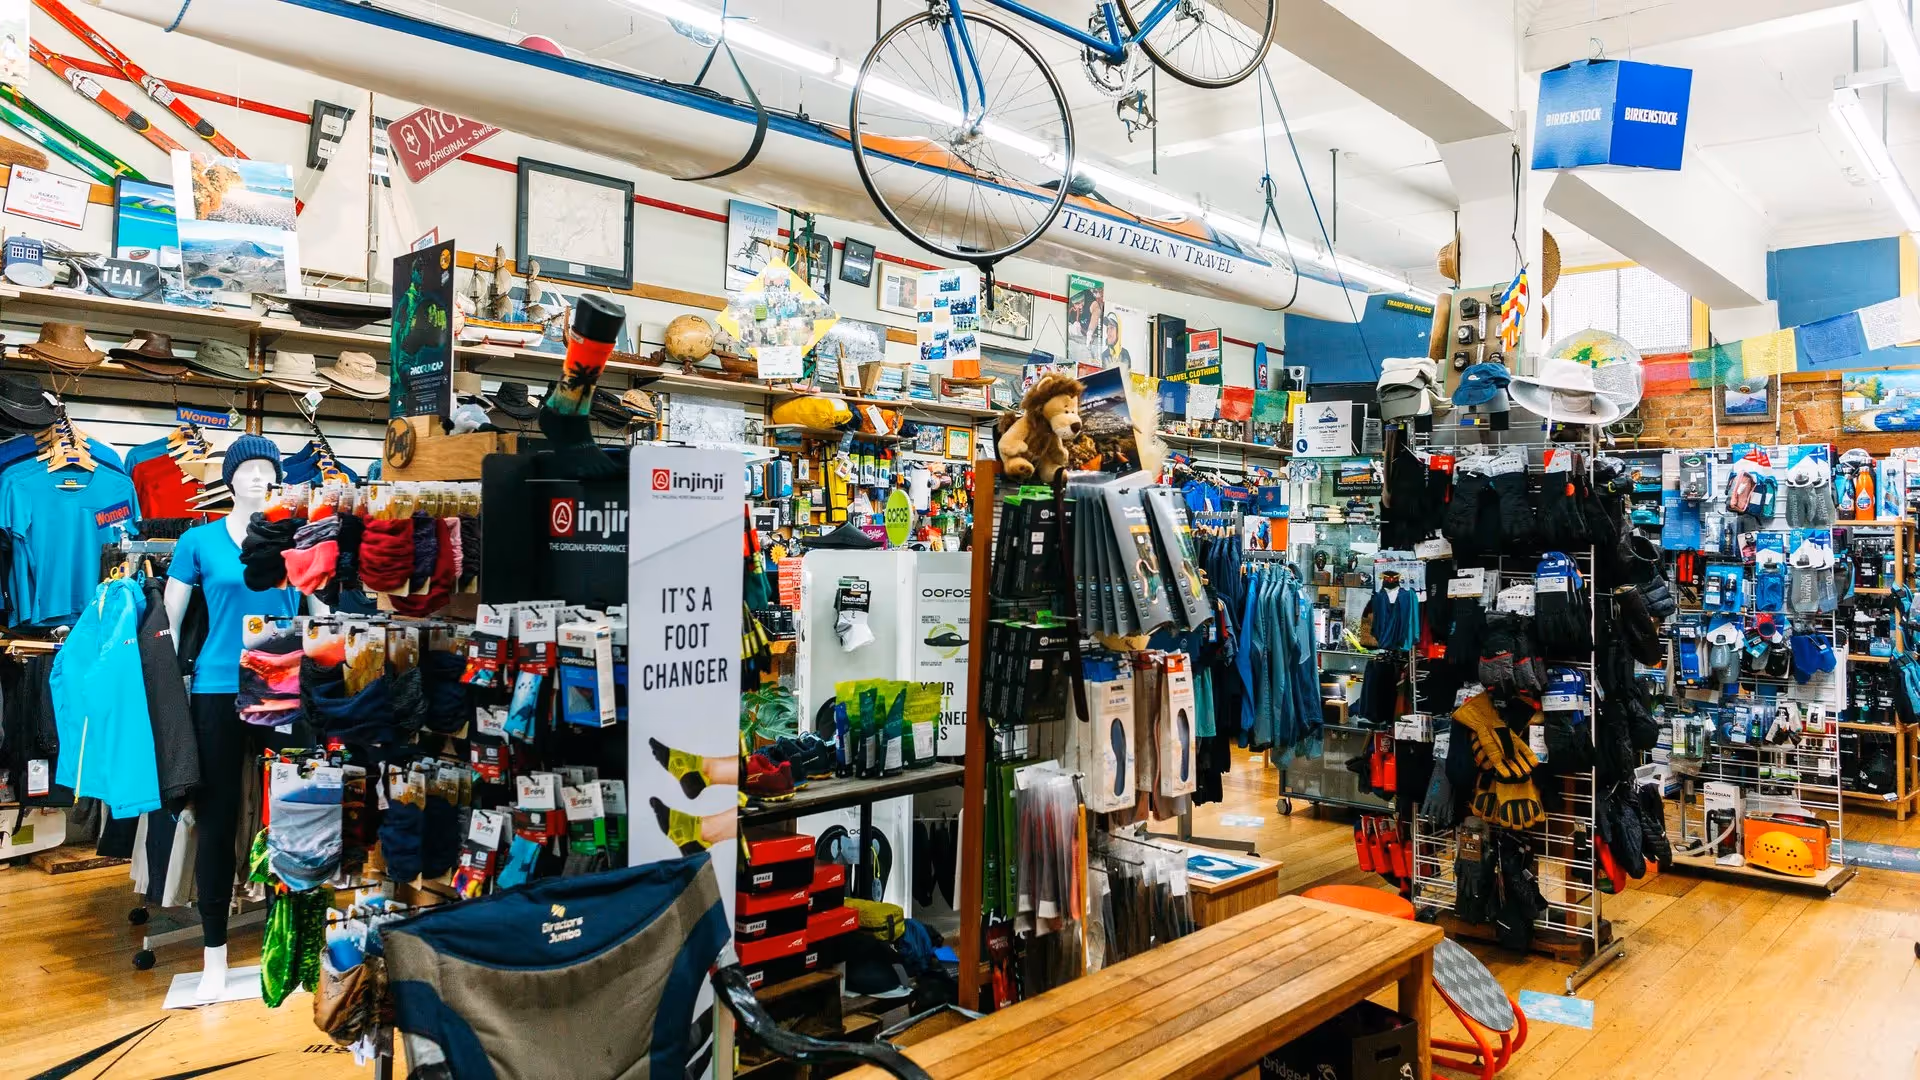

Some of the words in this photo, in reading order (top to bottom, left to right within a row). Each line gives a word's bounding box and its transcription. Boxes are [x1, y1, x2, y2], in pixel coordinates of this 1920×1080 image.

[1545, 107, 1602, 127] BIRKENSTOCK
[1624, 107, 1678, 126] BIRKENSTOCK
[415, 158, 431, 171] The
[430, 137, 468, 162] ORIGINAL
[1118, 226, 1163, 255] TREK
[103, 265, 143, 288] TEAL
[1414, 304, 1432, 314] PACKS
[1166, 372, 1188, 383] TRAVEL
[1189, 366, 1220, 379] CLOTHING
[179, 409, 227, 426] Women
[673, 471, 724, 493] injinji
[1223, 487, 1248, 499] Women
[95, 505, 130, 526] Women
[887, 507, 908, 523] OOFOS
[549, 542, 560, 551] THE
[560, 542, 585, 552] ORIGINAL
[585, 542, 626, 553] PERFORMANCE
[662, 587, 695, 614] IT'S
[702, 586, 712, 612] A
[922, 588, 971, 598] OOFOS
[665, 622, 710, 652] FOOT
[643, 657, 728, 691] CHANGER
[1705, 790, 1731, 798] GUARDIAN
[755, 874, 771, 883] SPACE
[749, 922, 765, 931] SPACE
